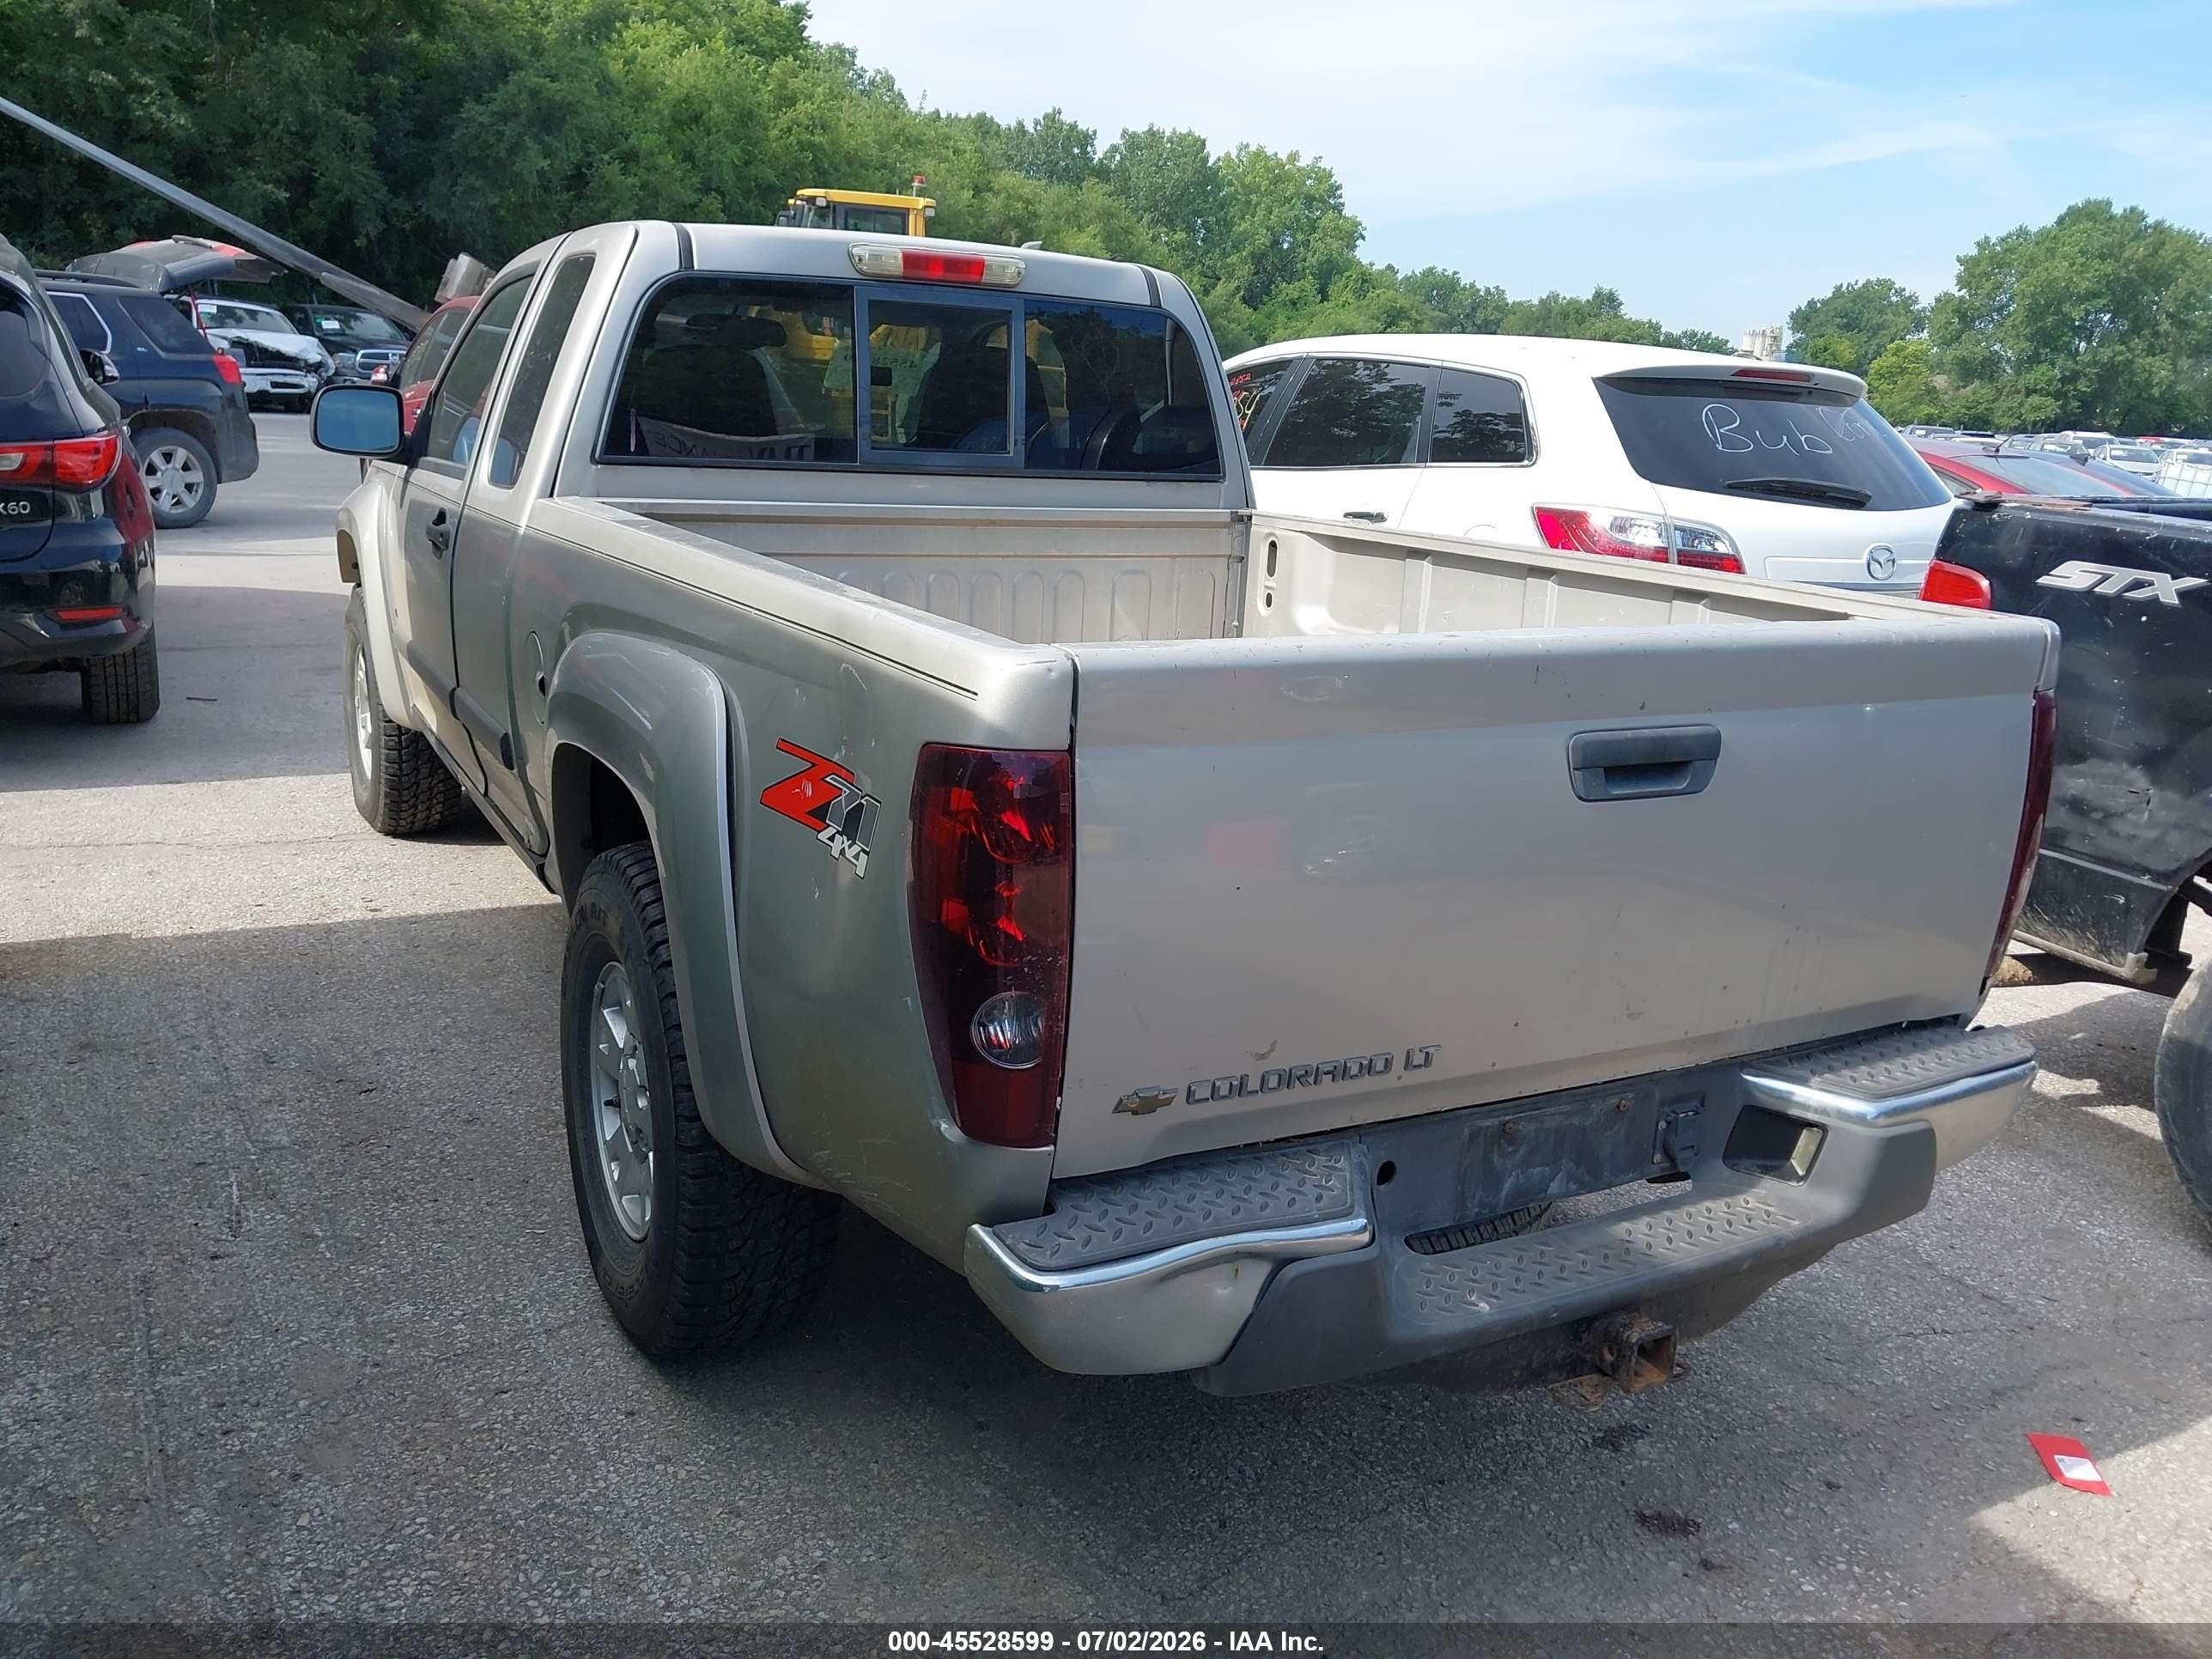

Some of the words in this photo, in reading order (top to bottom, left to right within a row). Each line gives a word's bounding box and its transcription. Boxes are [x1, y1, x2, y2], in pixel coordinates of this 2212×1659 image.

[1702, 404, 1833, 456] Bub
[2034, 560, 2212, 607] STX
[760, 738, 881, 852] Z71
[1185, 1051, 1395, 1105] COLORADO
[1403, 1043, 1443, 1072] LT
